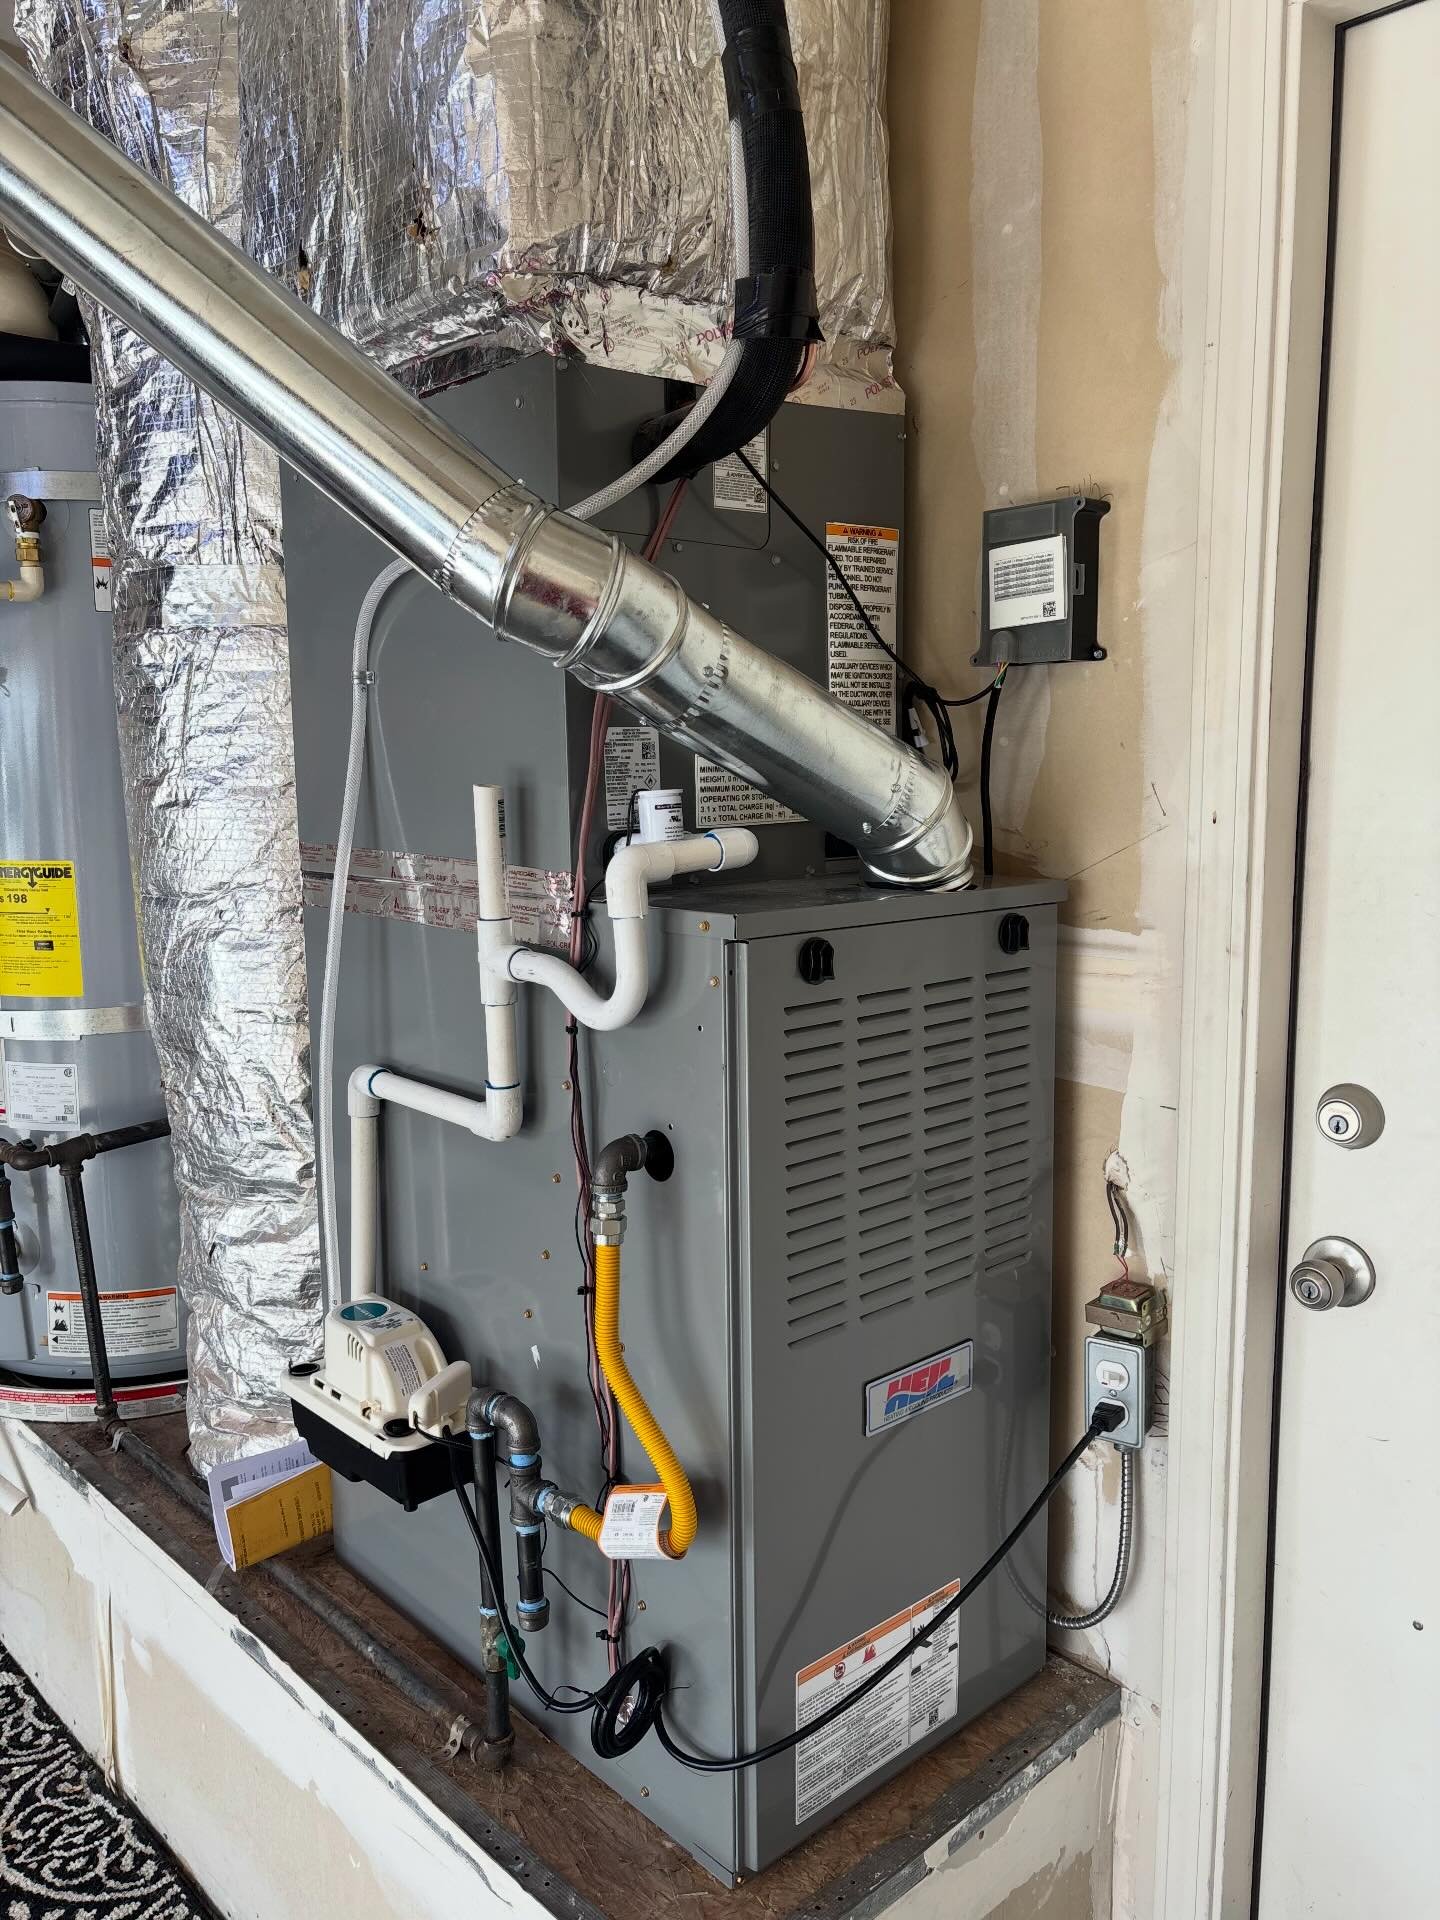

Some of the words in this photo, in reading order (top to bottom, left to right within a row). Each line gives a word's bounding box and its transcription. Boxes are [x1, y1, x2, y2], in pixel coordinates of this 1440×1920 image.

[850, 527, 876, 536] WARNING
[828, 544, 862, 553] FLAMMABLE
[863, 546, 896, 557] REFRIGERANT
[845, 554, 853, 562] TO
[863, 556, 887, 565] REPAIRED
[843, 564, 852, 572] BY
[853, 565, 875, 573] TRAINED
[876, 567, 894, 576] SERVICE
[860, 584, 892, 594] REFRIGERANT
[829, 603, 854, 611] DISPOSE
[829, 622, 855, 630] FEDERAL
[856, 622, 865, 630] OR
[829, 641, 863, 649] FLAMMABLE
[860, 663, 880, 671] DEVICES
[853, 672, 873, 680] IGNITION
[830, 681, 849, 689] SHALL
[863, 709, 873, 717] USE
[873, 709, 884, 717] WITH
[884, 709, 892, 717] THE
[700, 775, 727, 784] HEIGHT,
[700, 785, 730, 793] MINIMUM
[731, 784, 750, 792] ROOM
[700, 794, 740, 804] (OPERATING
[700, 804, 710, 813] 3.1
[718, 804, 737, 812] TOTAL
[738, 802, 763, 811] CHARGE
[700, 815, 711, 825] (15
[718, 814, 738, 822] TOTAL
[739, 812, 763, 821] CHARGE
[6, 893, 28, 904] 198
